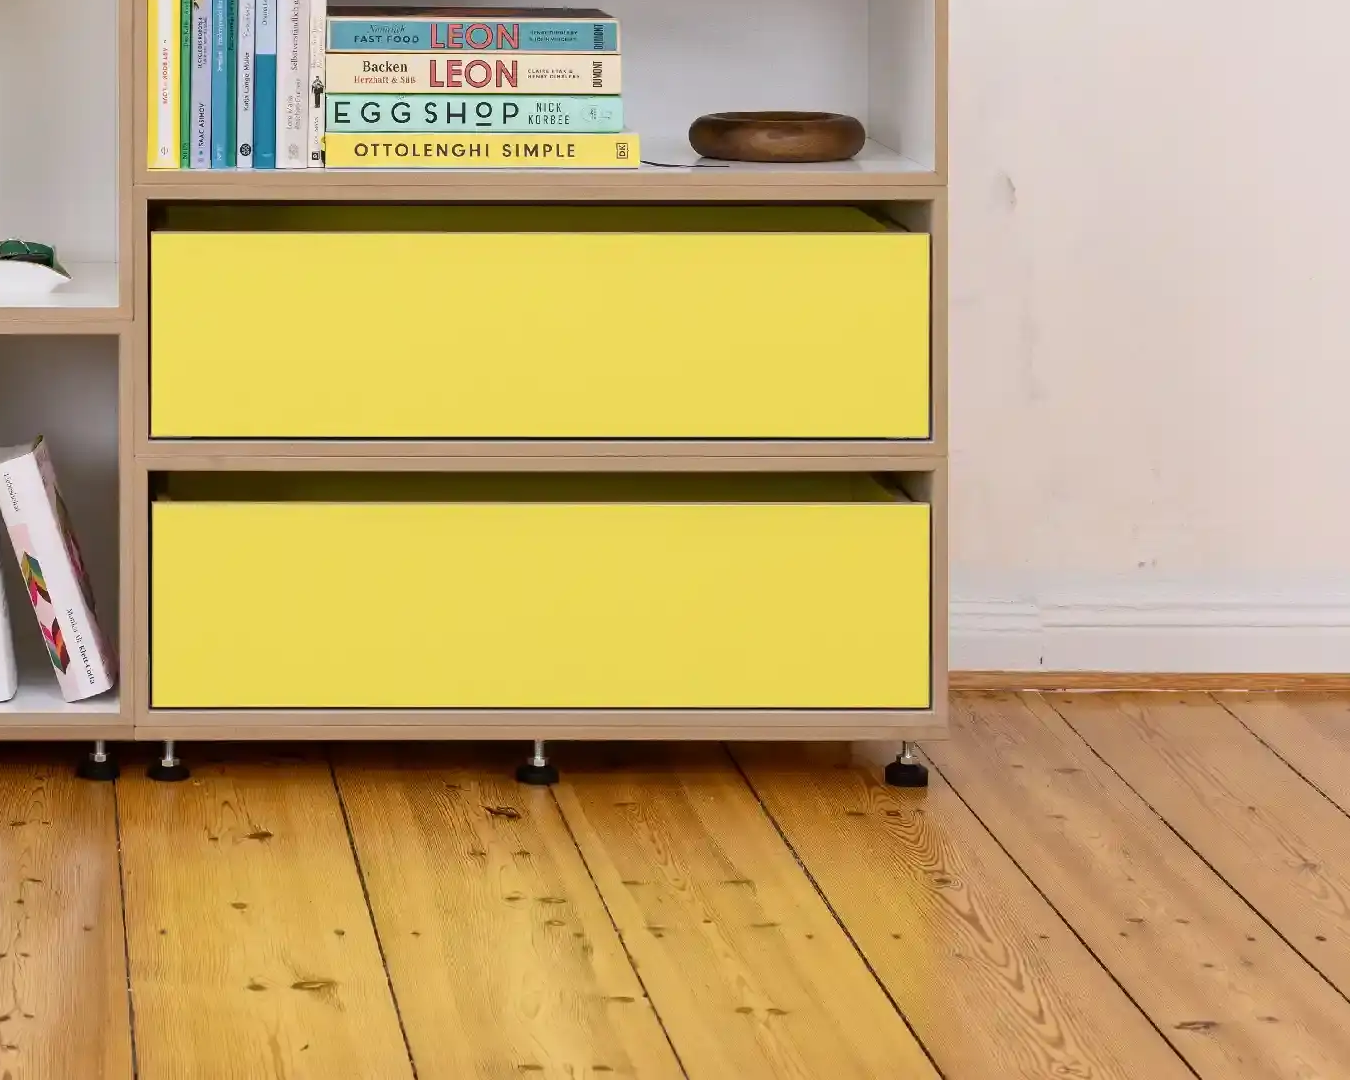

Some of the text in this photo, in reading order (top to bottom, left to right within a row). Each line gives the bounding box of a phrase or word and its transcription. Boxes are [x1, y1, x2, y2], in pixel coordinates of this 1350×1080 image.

[354, 35, 420, 43] FAST FOOD
[430, 23, 520, 50] LEON
[593, 23, 604, 50] DUMONT
[362, 60, 408, 73] Backen
[429, 59, 518, 88] LEON
[391, 76, 398, 84] &
[592, 60, 603, 88] DUMONT
[536, 102, 562, 113] NICK
[528, 114, 570, 125] KORBEE
[354, 143, 576, 158] OTTOLENGHI SIMPLE
